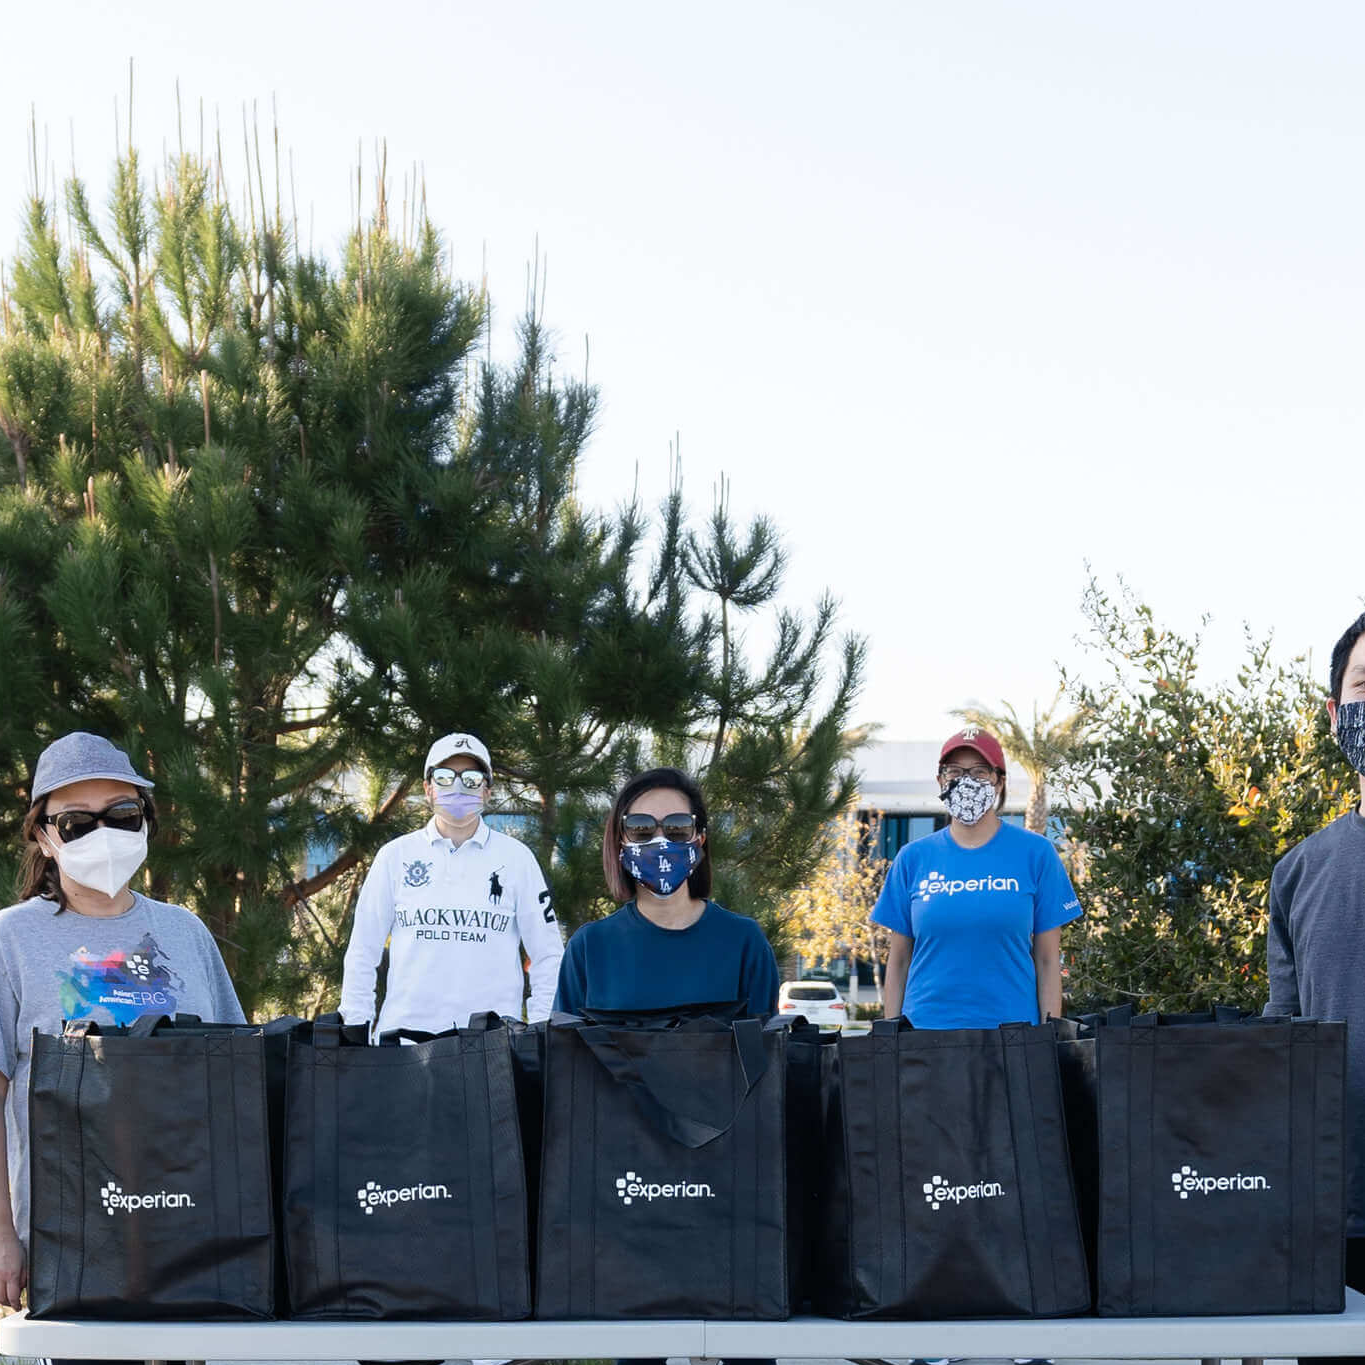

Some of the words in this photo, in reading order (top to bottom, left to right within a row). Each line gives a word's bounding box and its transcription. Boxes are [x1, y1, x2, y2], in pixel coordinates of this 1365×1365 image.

[658, 855, 672, 873] LA
[928, 875, 1020, 897] experian
[538, 889, 556, 924] 2
[416, 930, 450, 941] POLO
[452, 931, 487, 943] TEAM
[133, 991, 167, 1006] ERG
